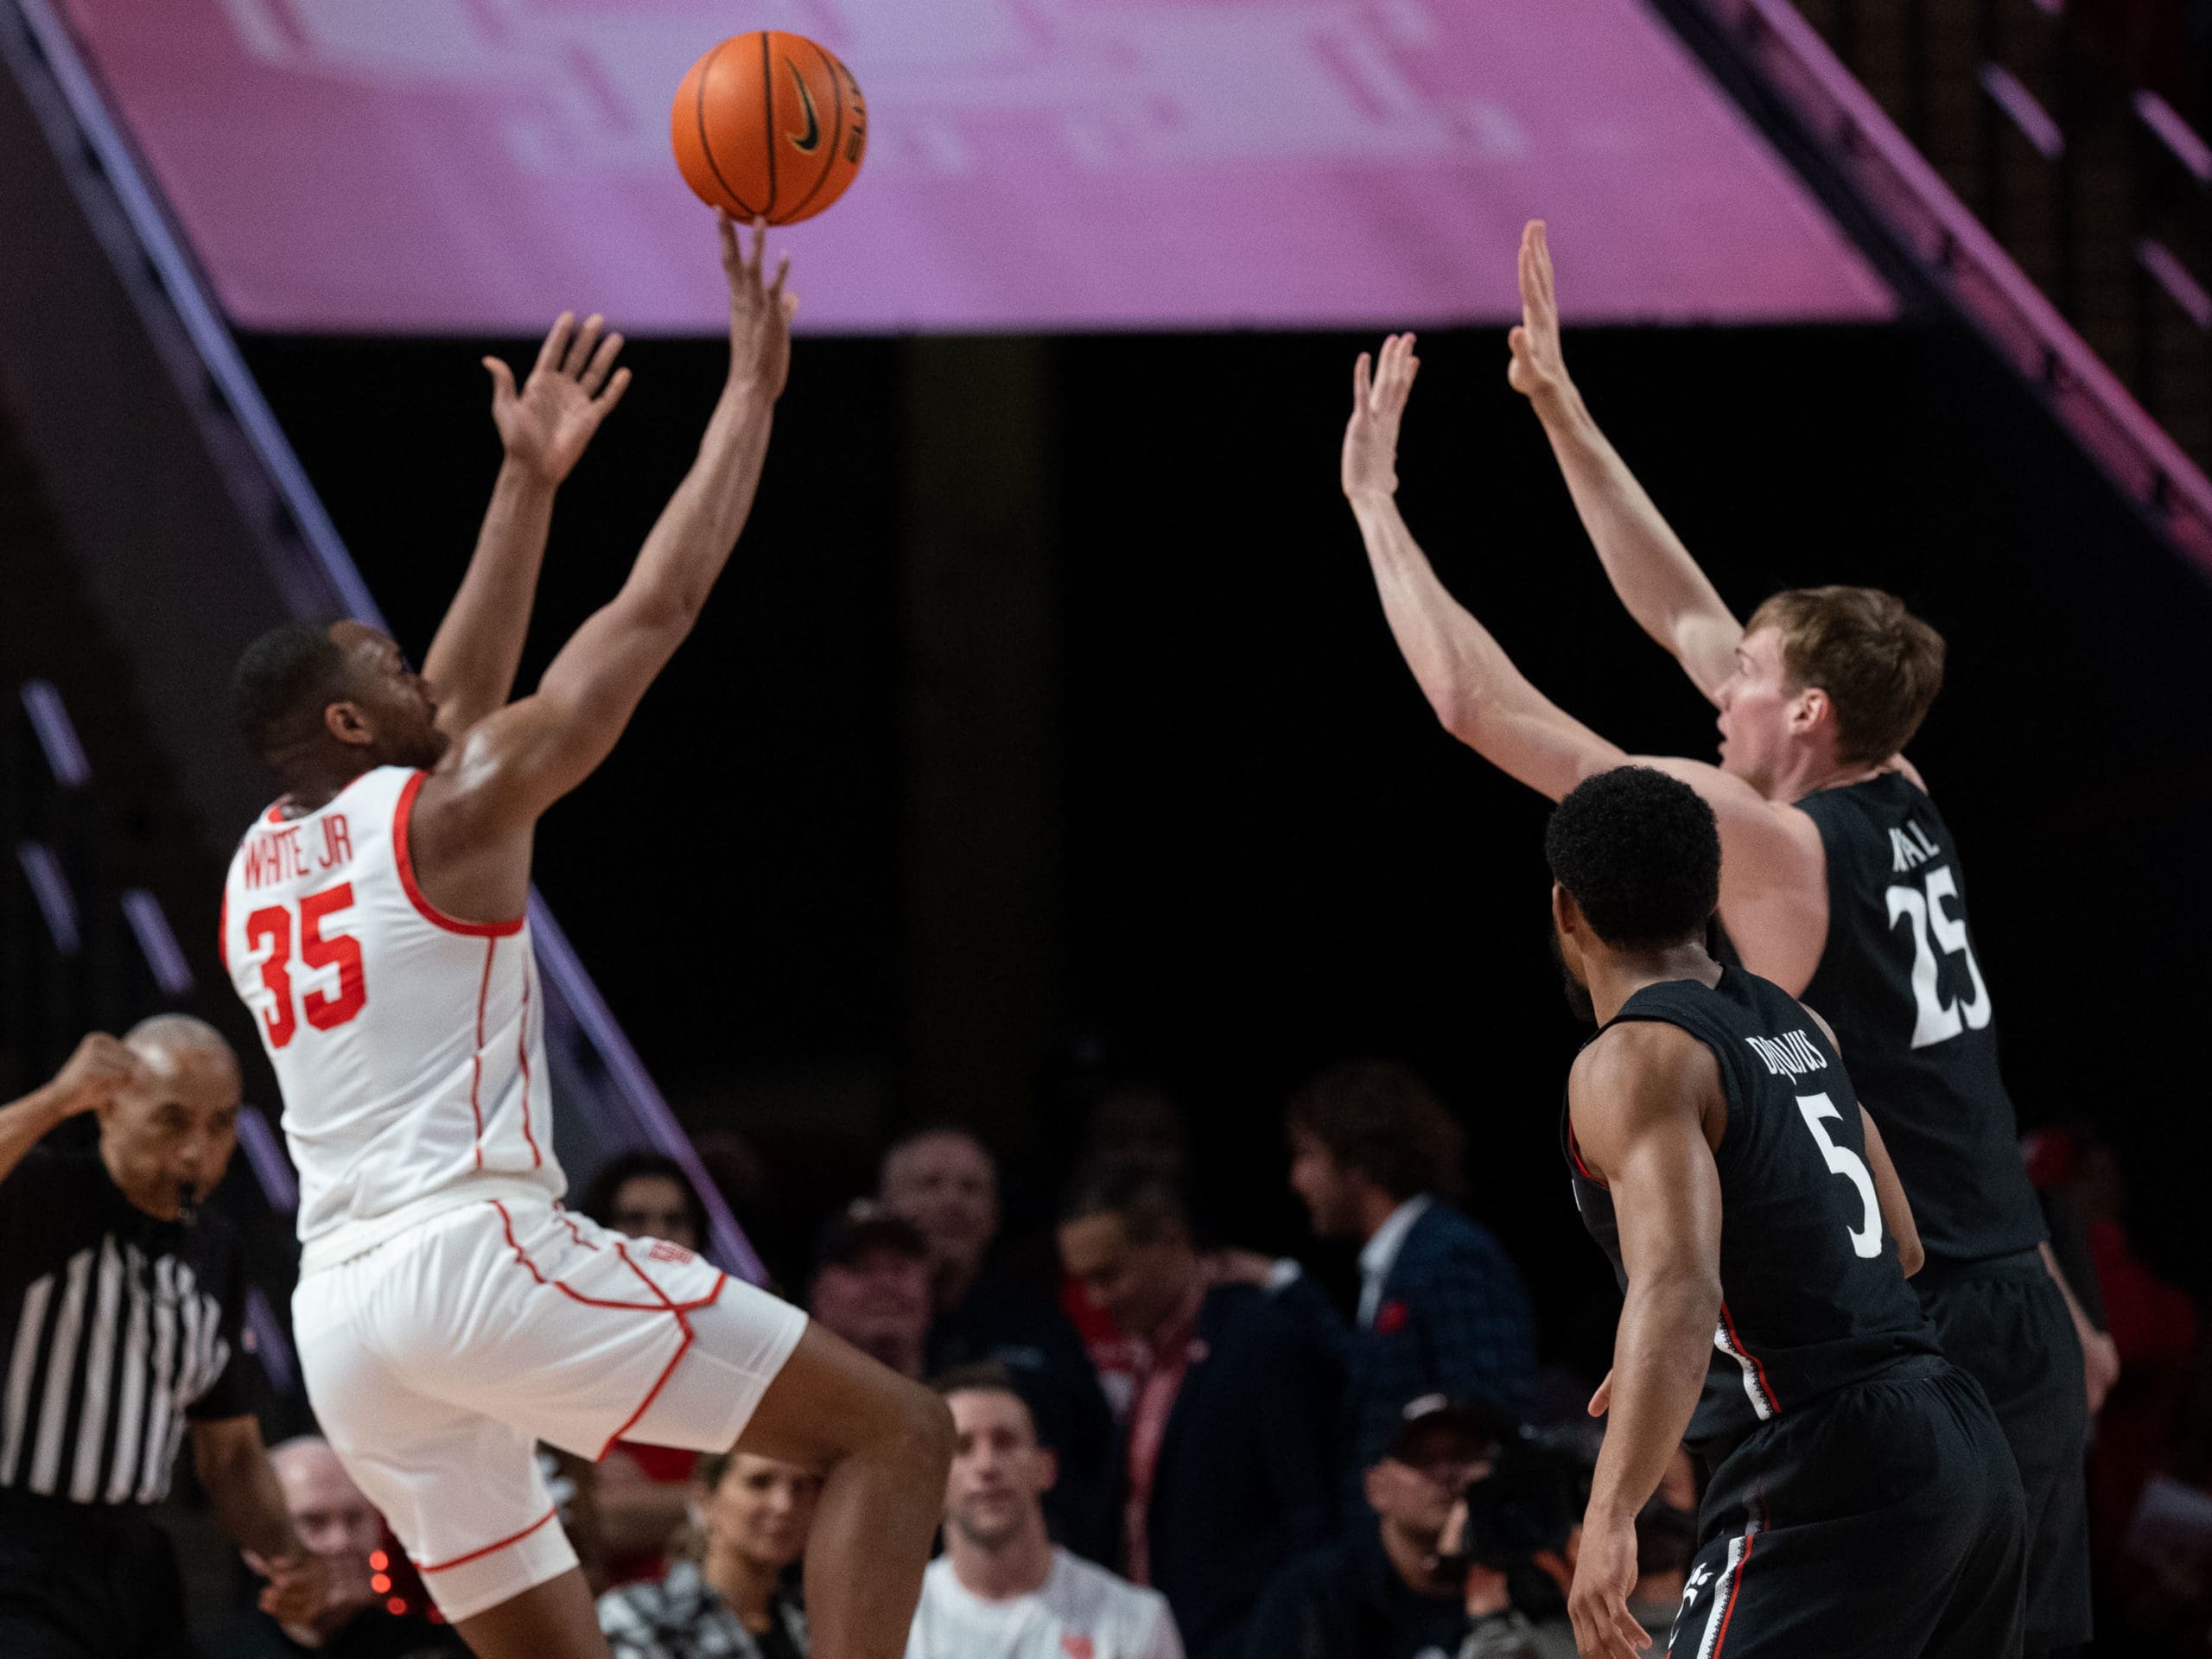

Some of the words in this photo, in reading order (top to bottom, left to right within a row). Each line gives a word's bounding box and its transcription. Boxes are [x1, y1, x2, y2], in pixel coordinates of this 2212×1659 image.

[243, 825, 310, 889] WHTE
[318, 814, 353, 868] JR
[245, 881, 367, 1049] 35
[1885, 864, 1991, 1051] 25
[1796, 1091, 1883, 1258] 5
